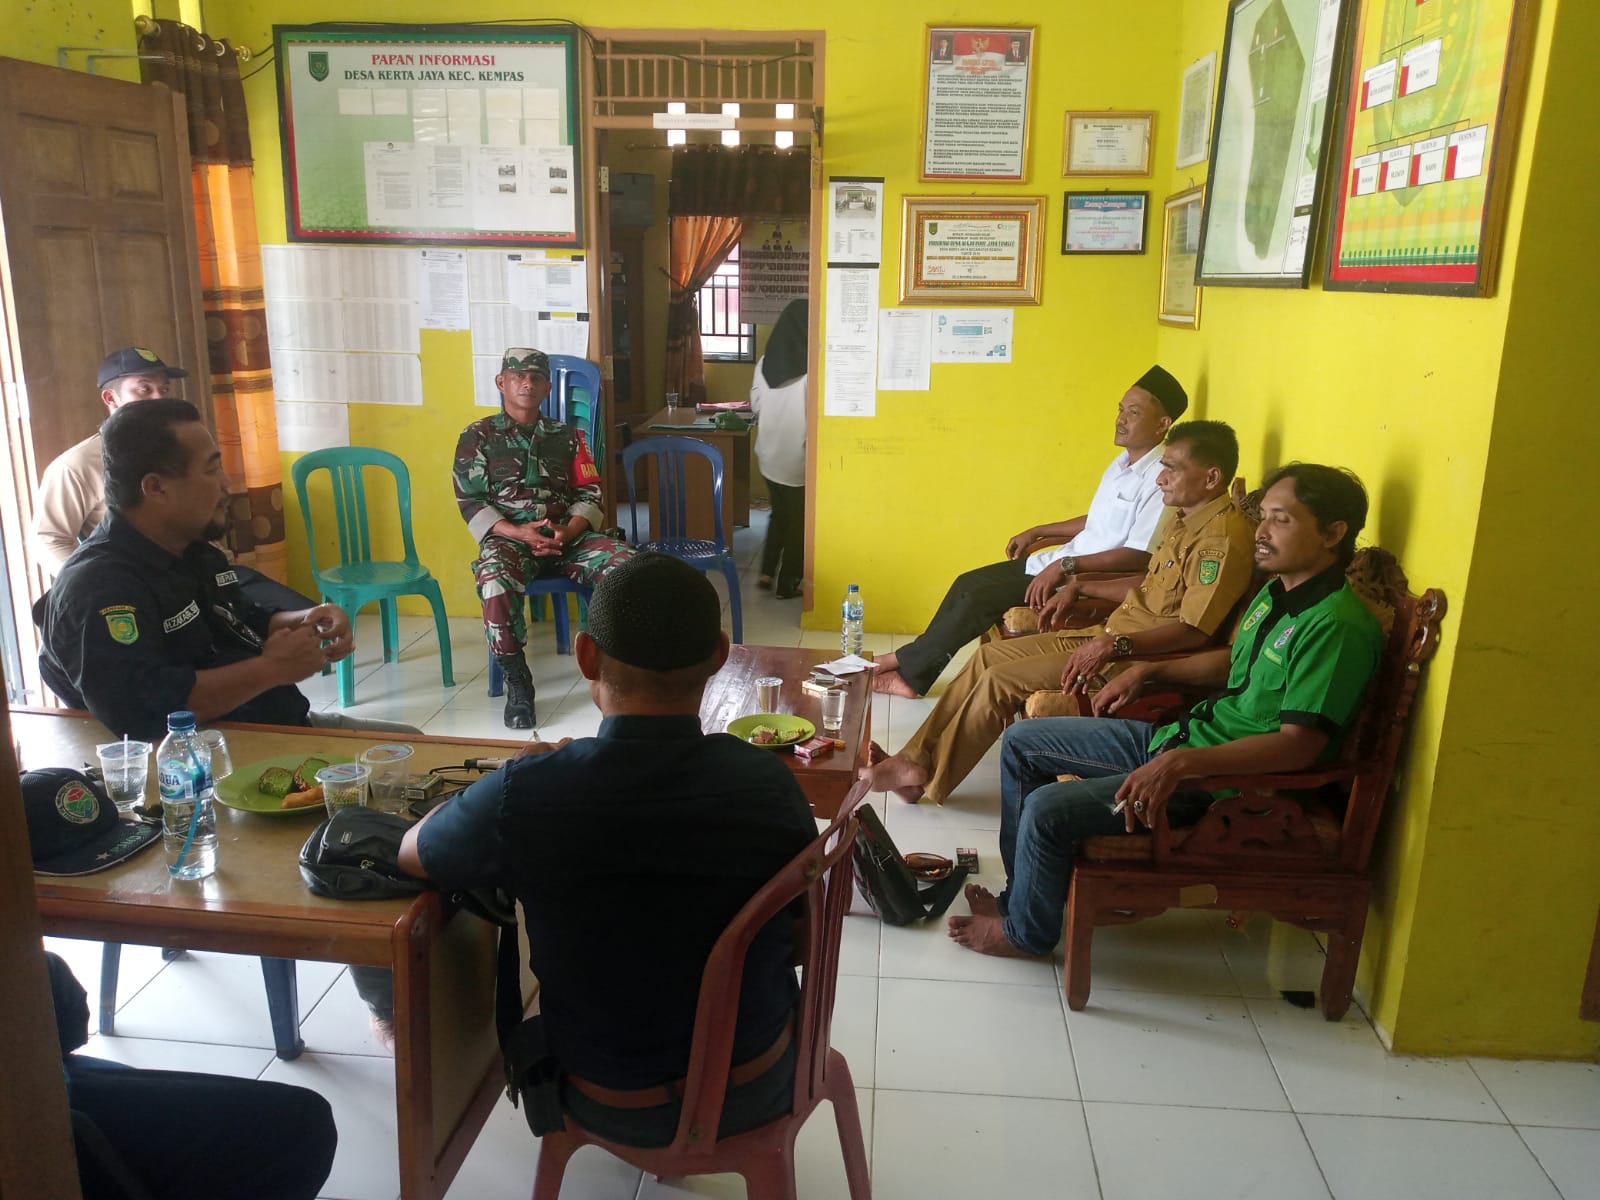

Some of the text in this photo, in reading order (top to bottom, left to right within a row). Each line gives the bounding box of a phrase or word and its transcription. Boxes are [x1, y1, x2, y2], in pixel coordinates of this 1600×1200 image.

[371, 54, 496, 66] PAPAN INFORMASI
[344, 70, 524, 82] DESA KERTA JAYA KEC. KEMPAS
